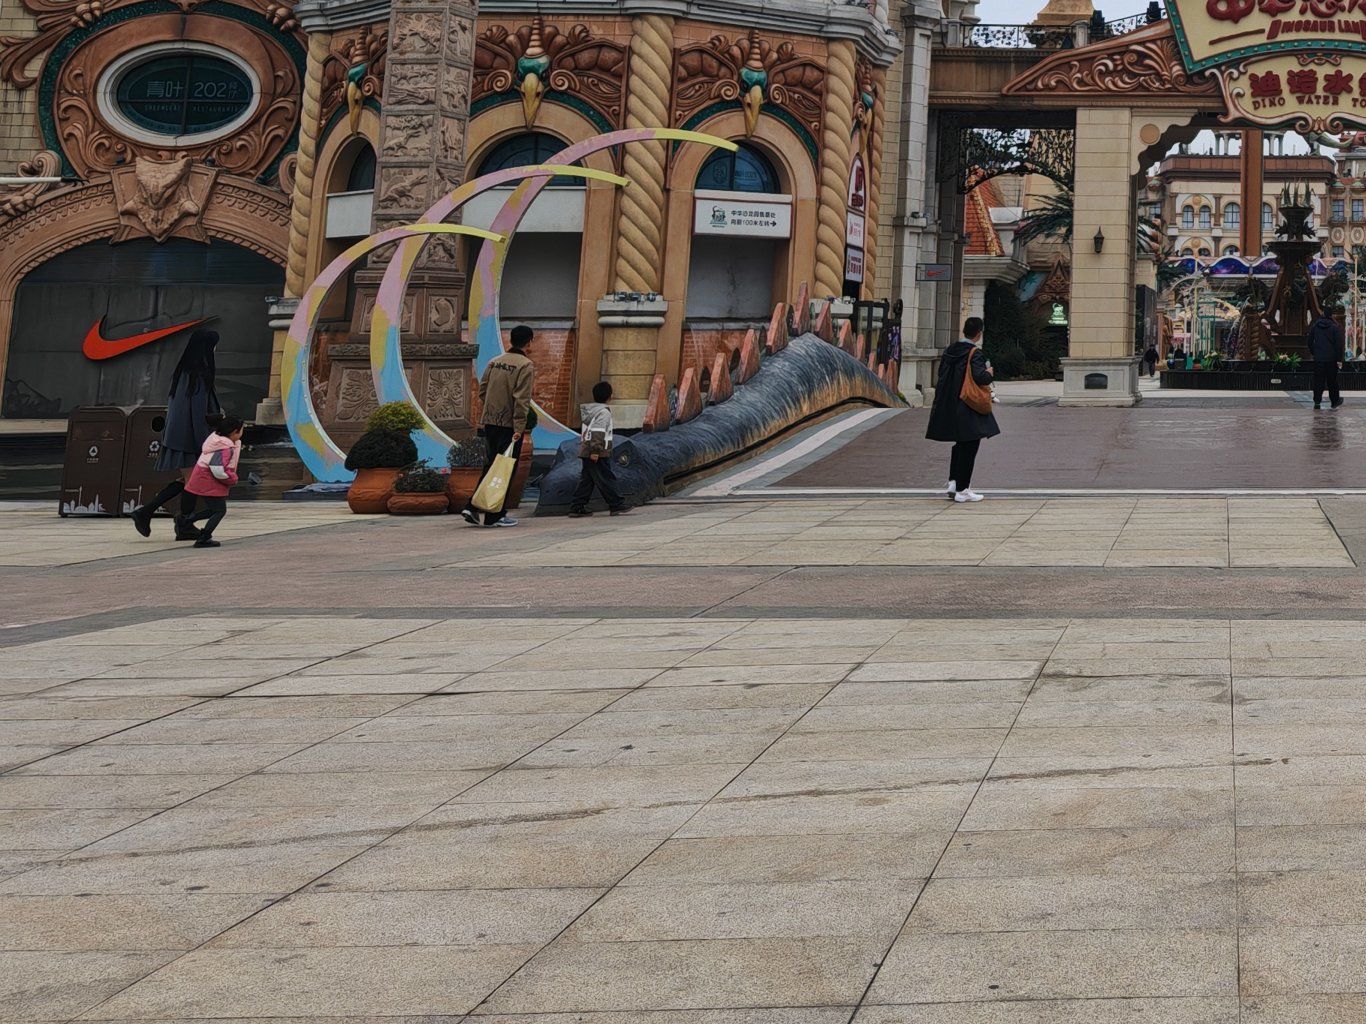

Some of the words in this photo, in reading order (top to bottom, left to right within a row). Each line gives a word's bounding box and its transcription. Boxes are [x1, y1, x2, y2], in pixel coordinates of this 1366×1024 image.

[1266, 19, 1336, 40] DINOSAUR
[146, 81, 184, 98] 青叶
[1252, 97, 1286, 111] DINO
[1296, 95, 1340, 106] WATER
